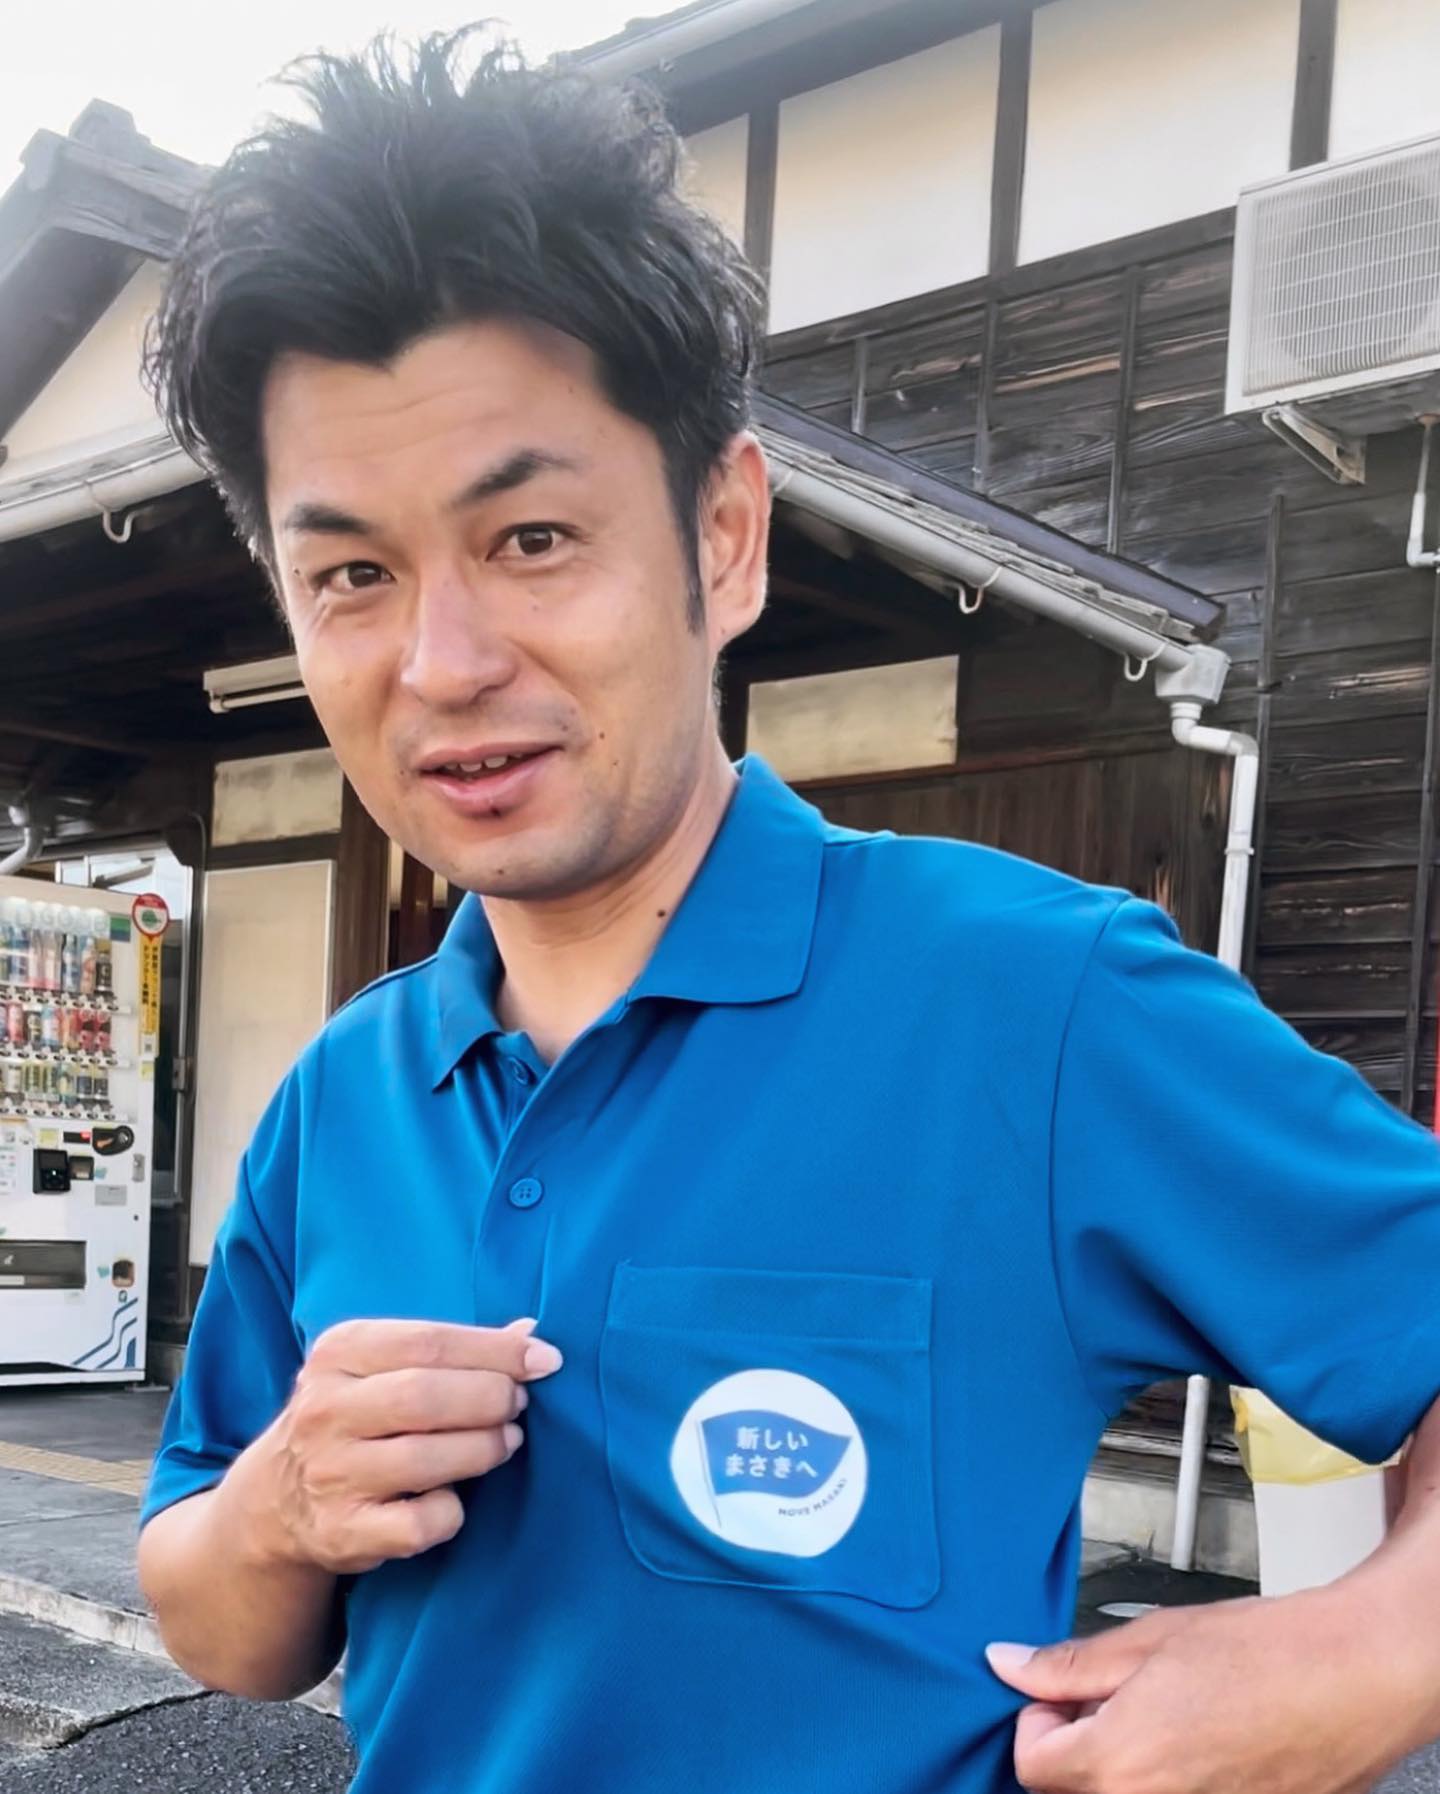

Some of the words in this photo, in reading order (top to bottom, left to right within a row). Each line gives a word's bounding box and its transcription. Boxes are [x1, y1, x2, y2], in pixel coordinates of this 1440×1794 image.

[736, 1426, 809, 1451] 新しい
[725, 1453, 818, 1479] まさきへ
